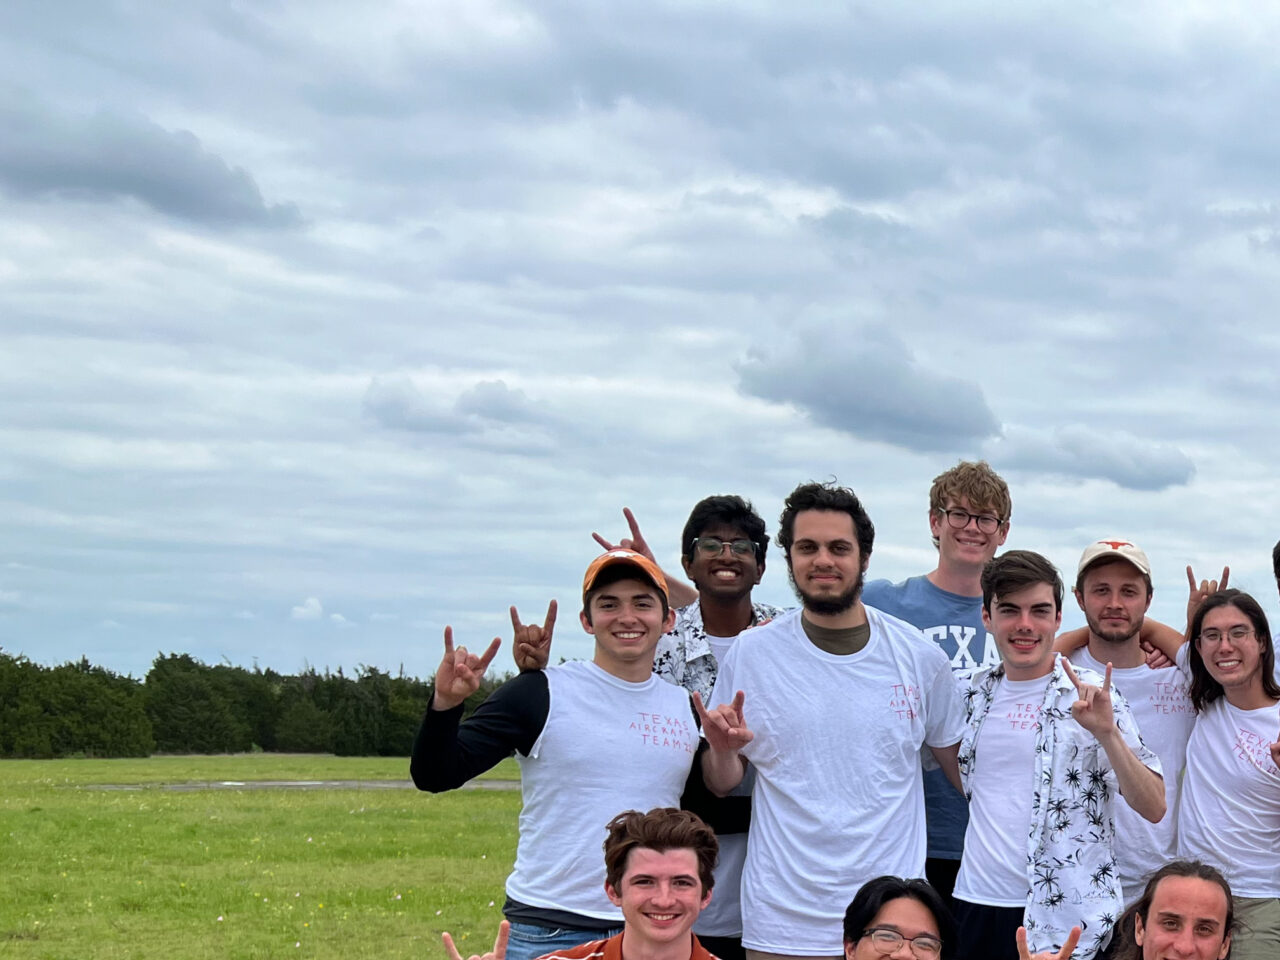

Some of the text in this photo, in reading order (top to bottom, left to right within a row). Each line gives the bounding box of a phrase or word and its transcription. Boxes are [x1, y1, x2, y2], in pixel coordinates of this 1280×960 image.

[636, 712, 689, 731] TEXAS
[642, 733, 682, 749] TEAM
[1239, 728, 1273, 751] TEXA
